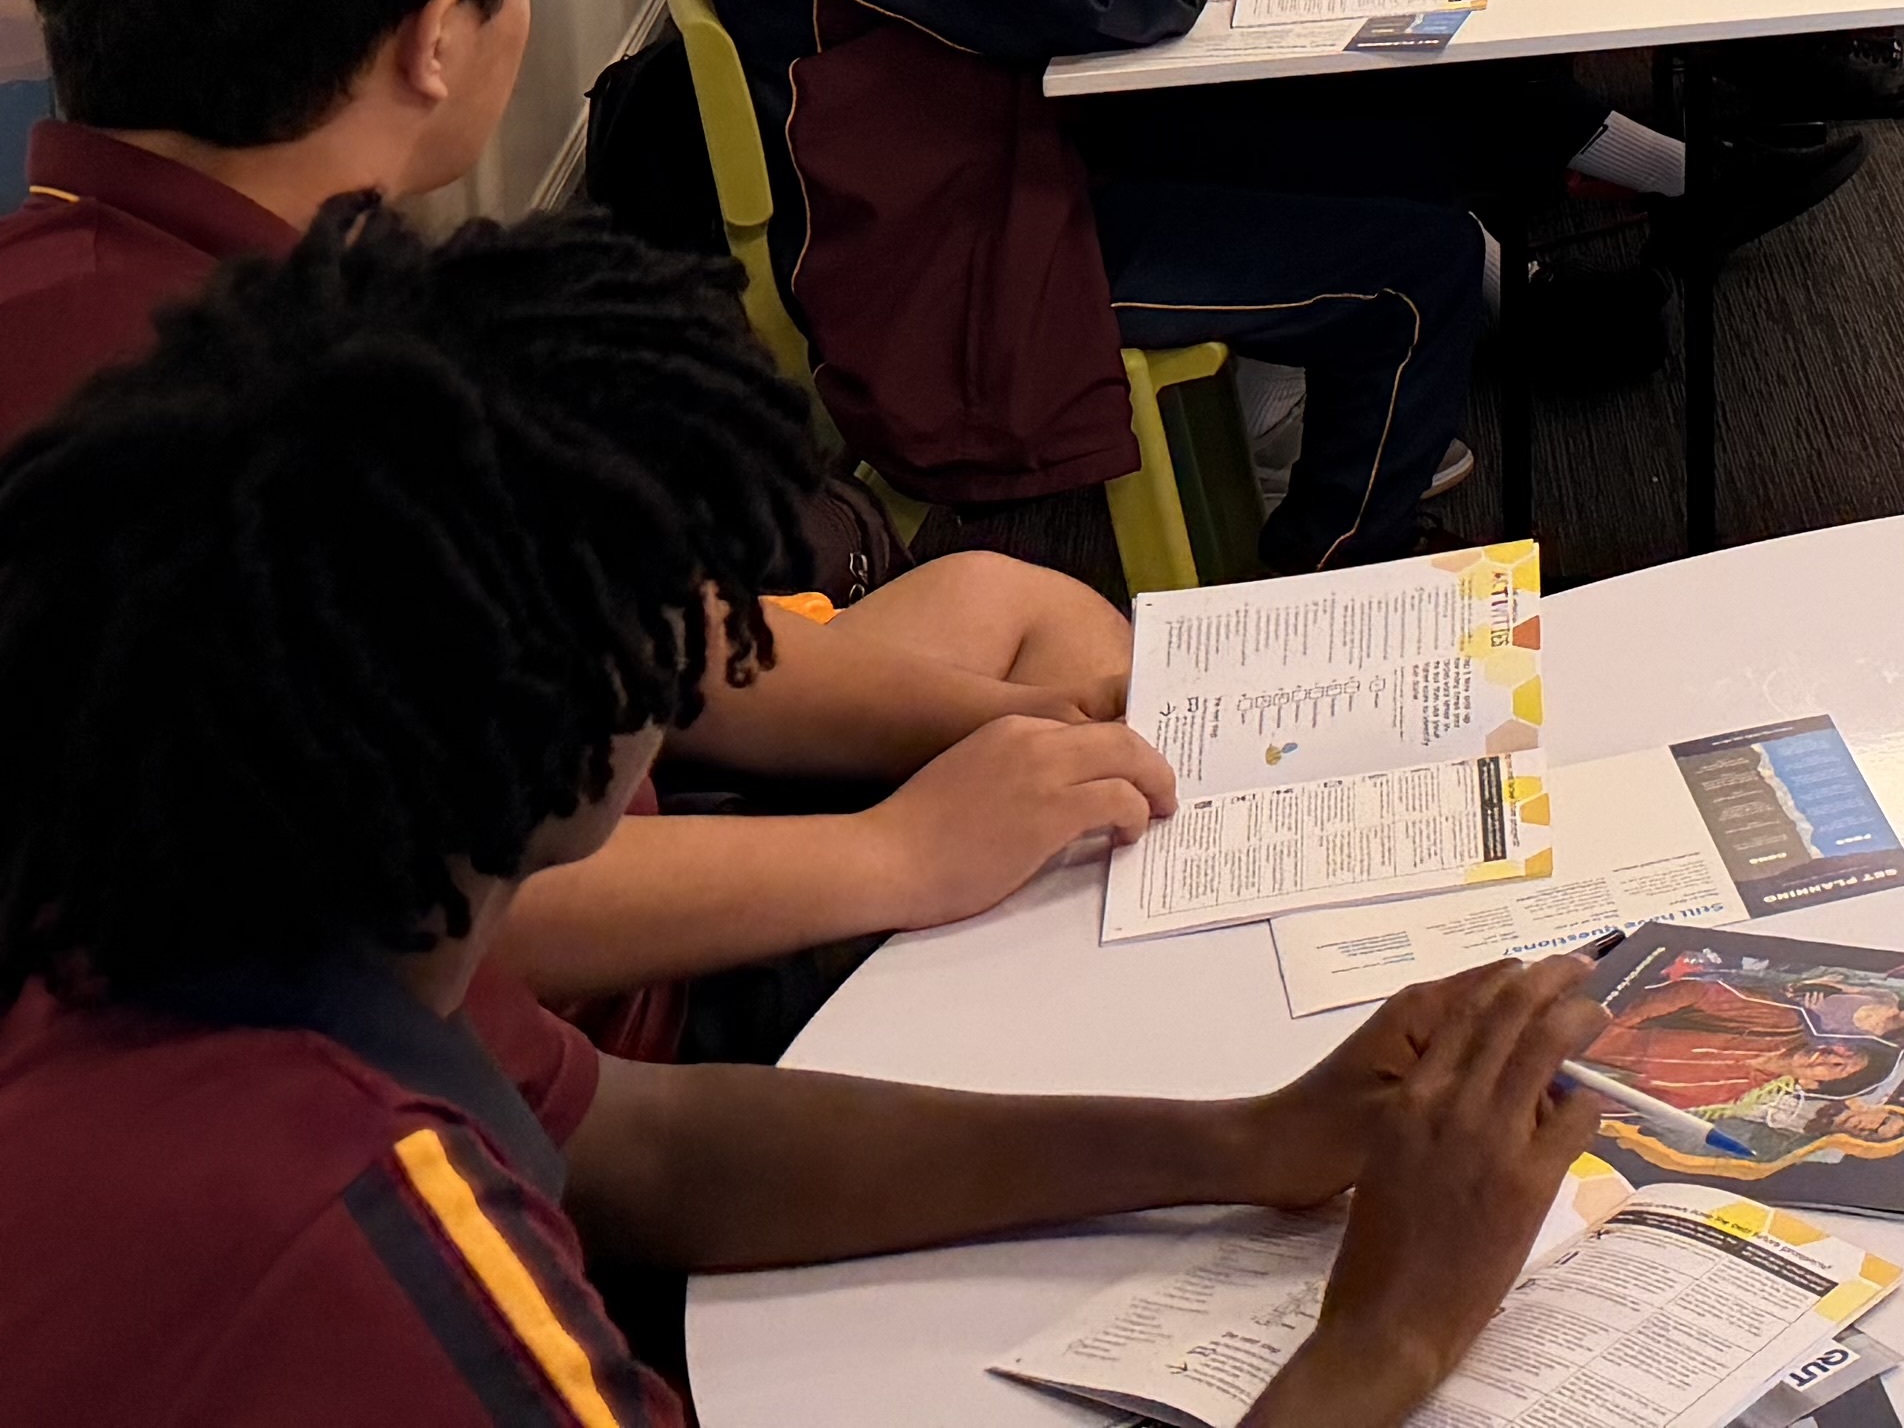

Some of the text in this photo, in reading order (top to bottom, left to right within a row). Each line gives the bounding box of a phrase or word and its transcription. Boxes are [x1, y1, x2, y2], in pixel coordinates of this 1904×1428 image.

[1763, 876, 1858, 904] PLANNING
[1680, 902, 1724, 918] Still
[1502, 924, 1619, 956] questions?
[1788, 1347, 1850, 1388] QUT
